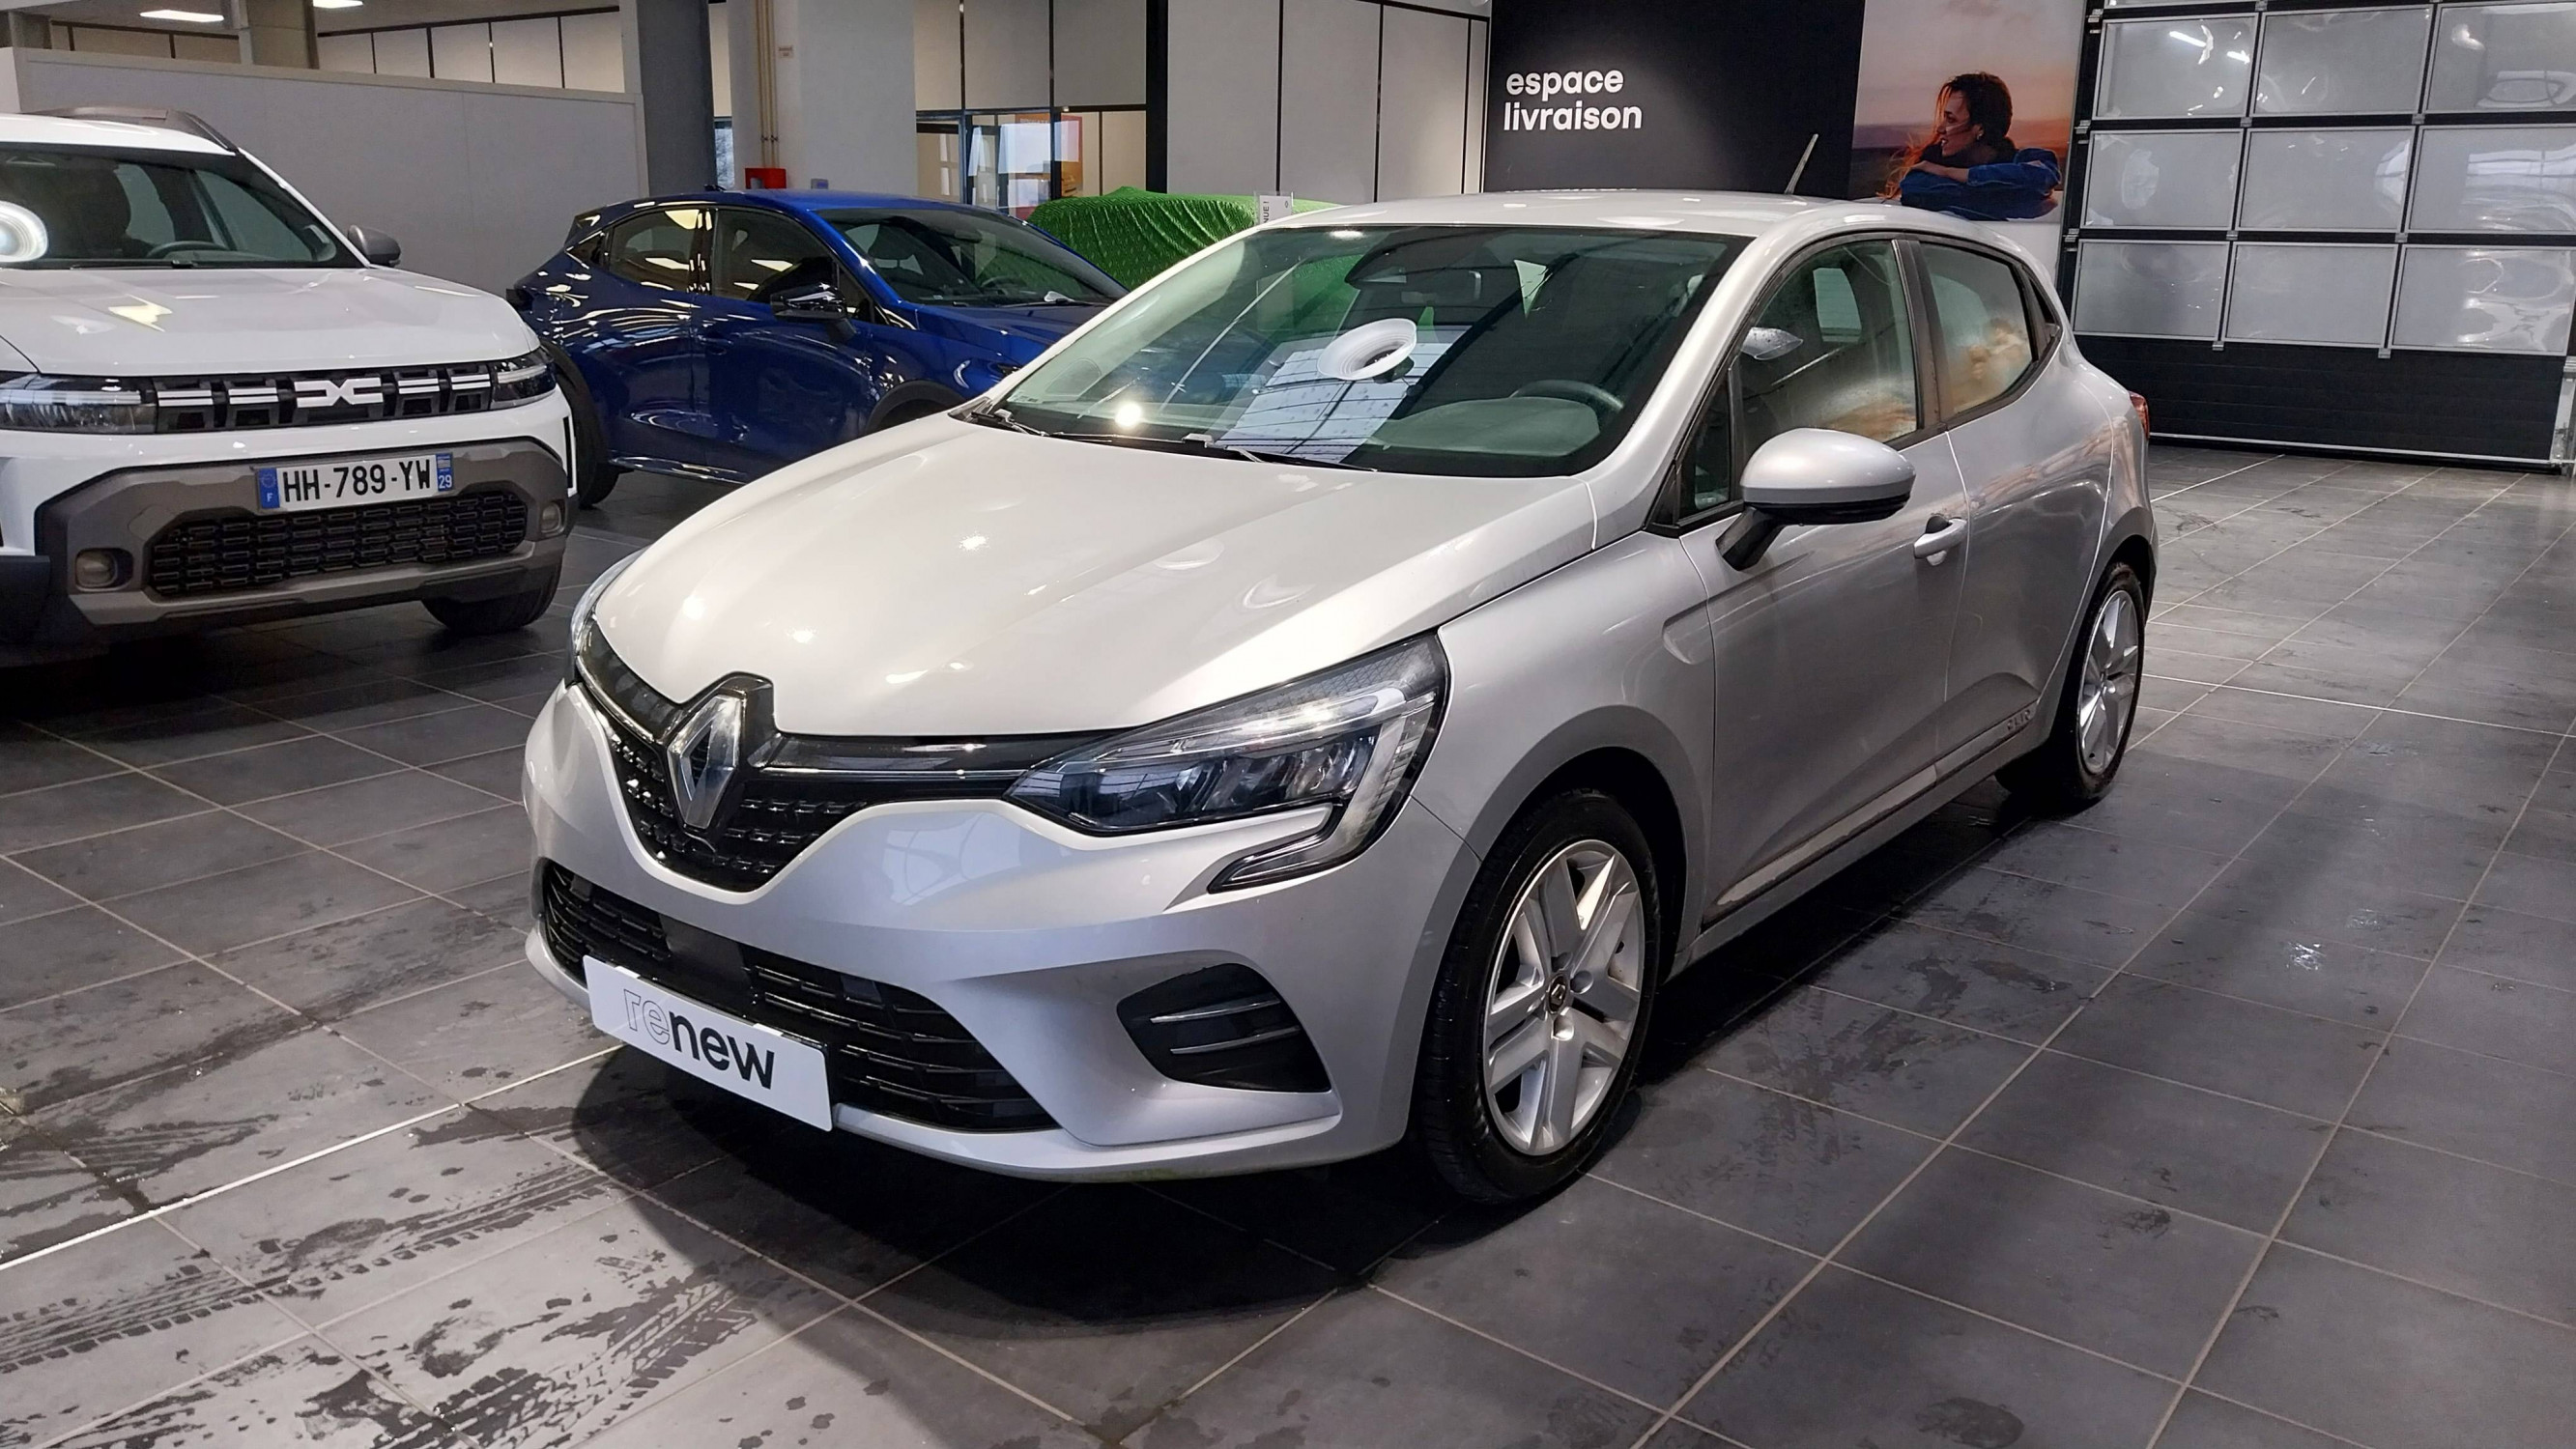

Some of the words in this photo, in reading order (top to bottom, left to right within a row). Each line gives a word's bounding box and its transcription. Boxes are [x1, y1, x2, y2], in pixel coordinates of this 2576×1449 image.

[1505, 70, 1624, 102] espace
[1503, 100, 1643, 130] livraison
[282, 459, 430, 502] HH-789-YW
[438, 474, 452, 489] 29
[267, 492, 273, 502] F
[623, 989, 775, 1090] renew
